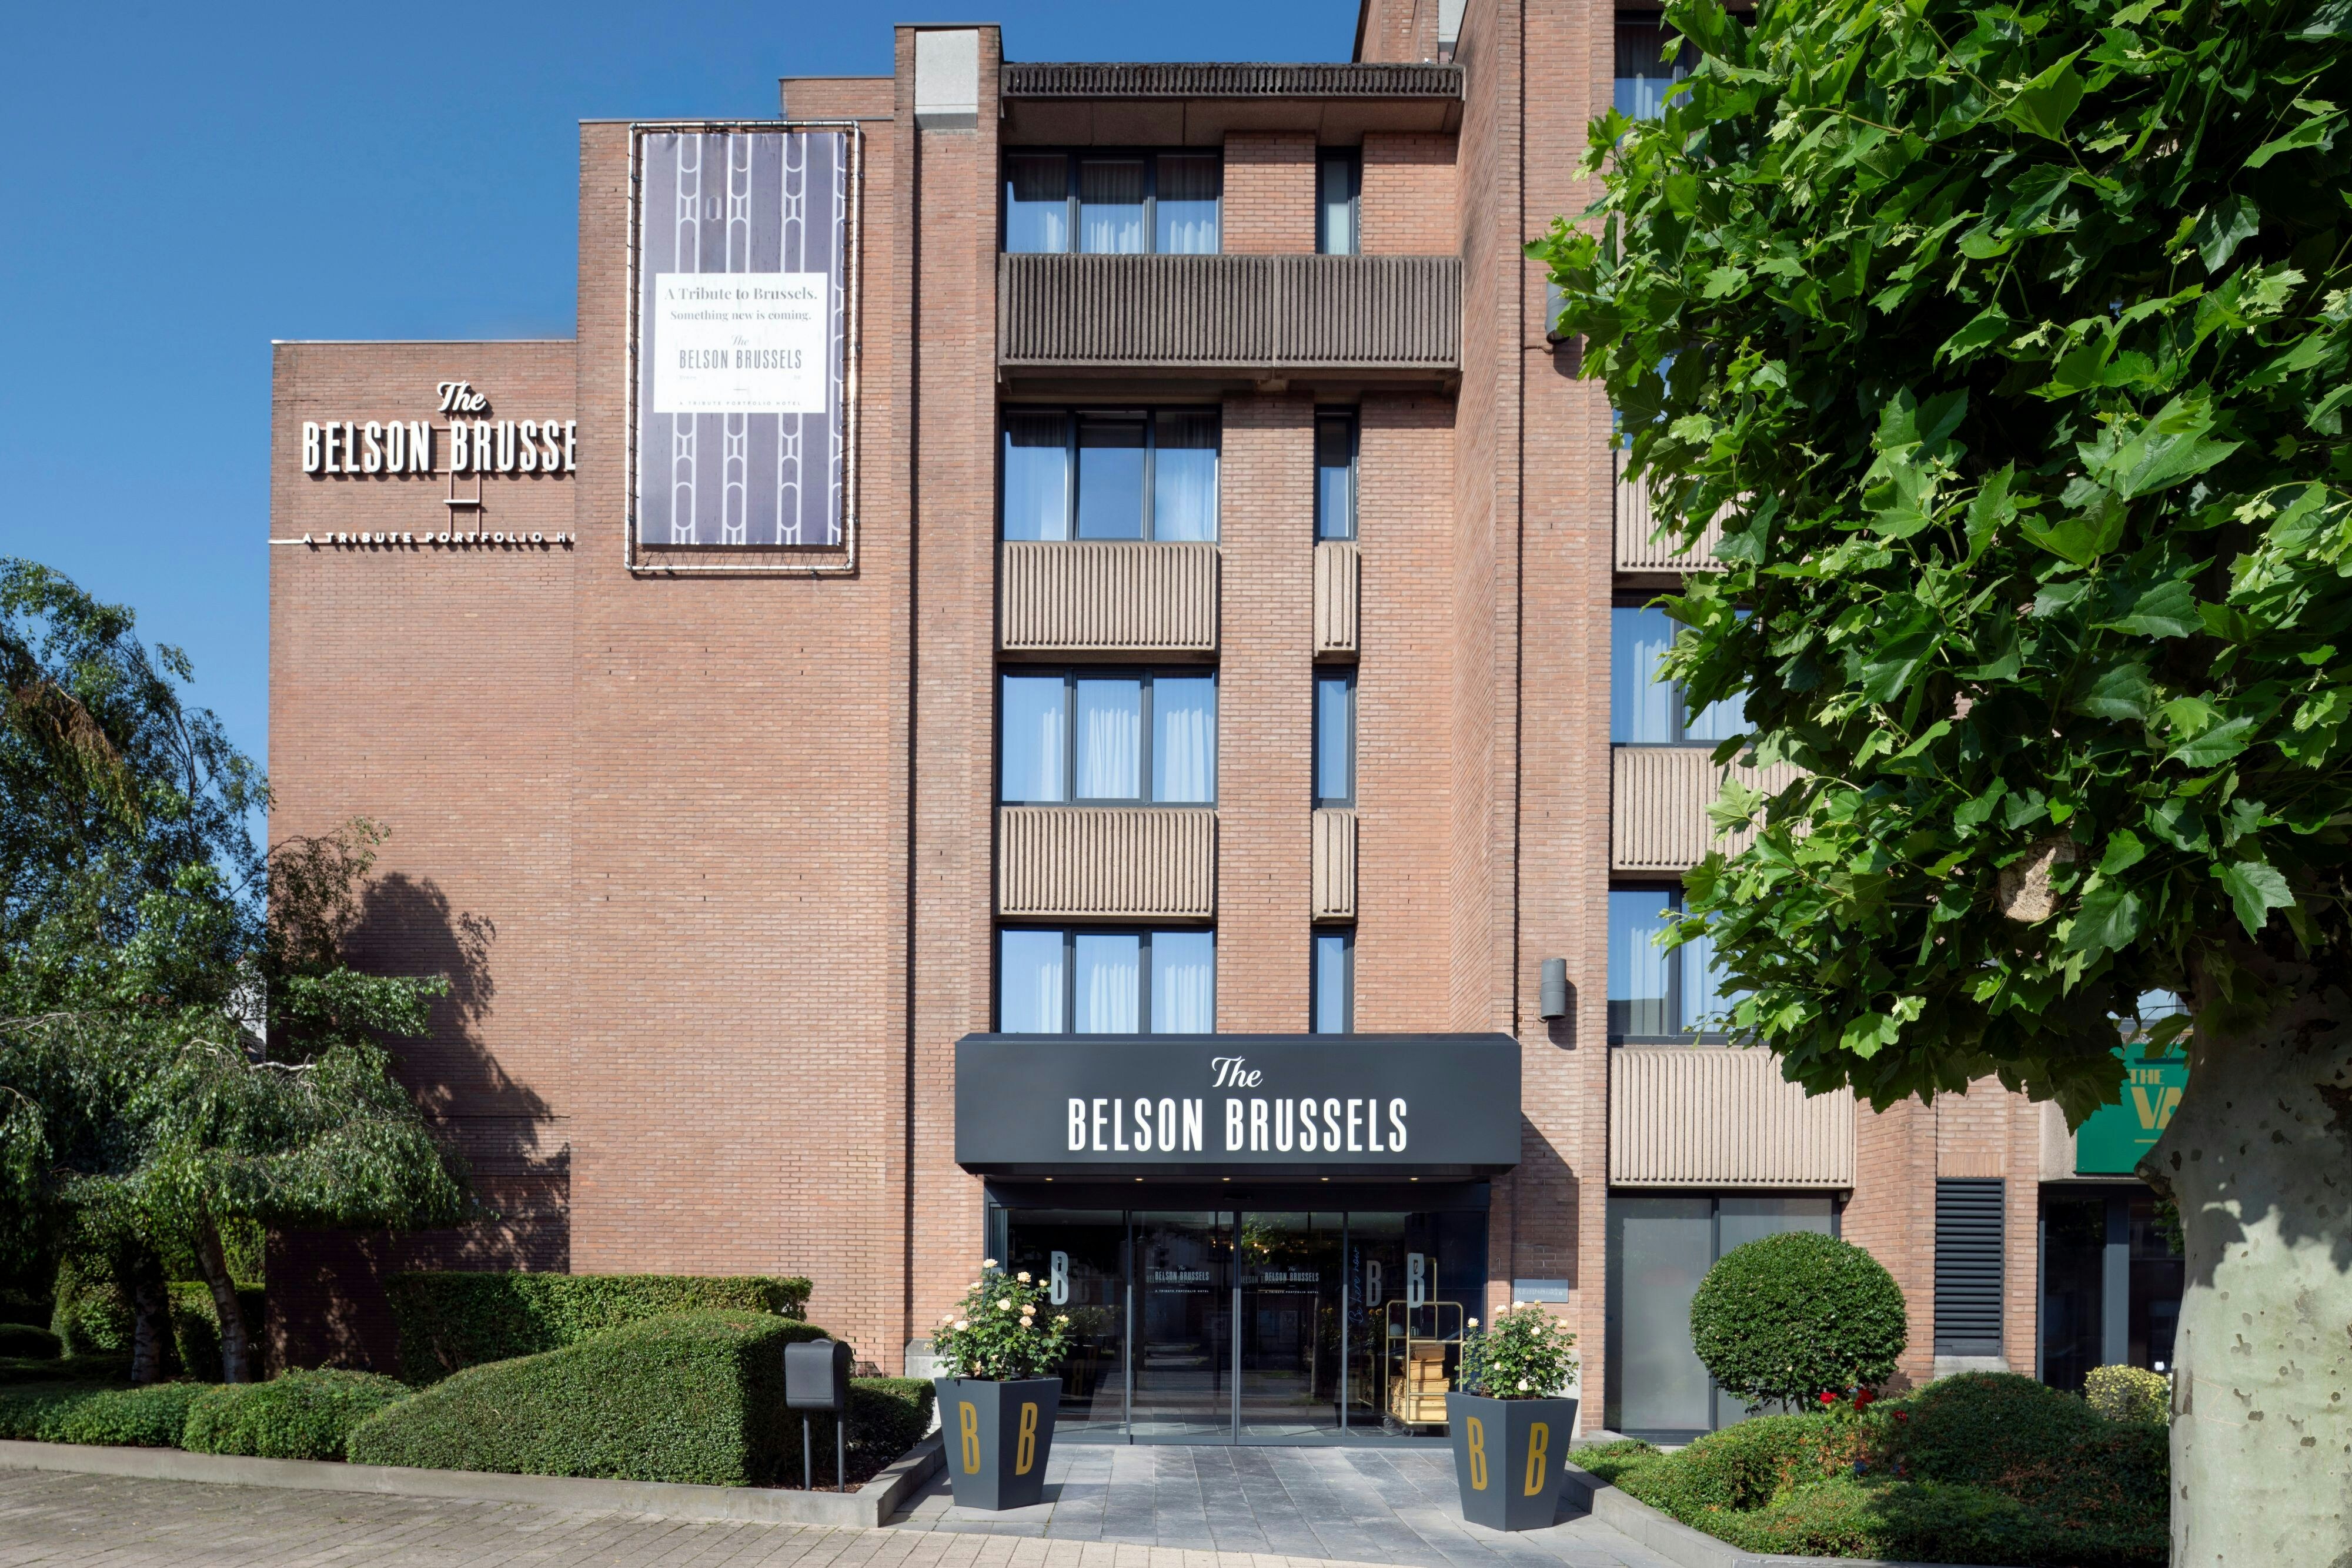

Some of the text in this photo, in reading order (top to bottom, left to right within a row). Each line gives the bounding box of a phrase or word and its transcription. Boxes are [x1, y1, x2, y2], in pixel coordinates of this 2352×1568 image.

[664, 287, 818, 300] A Tribute to Brussels.
[670, 310, 812, 322] Something new is coming.
[730, 334, 750, 346] The
[679, 349, 802, 369] BELSON BRUSSELS
[436, 380, 487, 412] The
[302, 420, 430, 472] BELSON
[302, 533, 312, 543] A
[325, 531, 412, 543] TRIBUTE
[425, 531, 543, 543] PORTFOLIO
[1211, 1055, 1263, 1088] The
[2126, 1069, 2165, 1084] THE
[1068, 1097, 1407, 1152] BELSON BRUSSELS
[1050, 1251, 1069, 1305] B
[1155, 1271, 1177, 1281] BELSON
[1180, 1271, 1210, 1281] BRUSSELS
[1265, 1272, 1287, 1282] BELSON
[1289, 1272, 1319, 1282] BRUSSELS
[1349, 1276, 1362, 1303] here
[1366, 1260, 1382, 1307] B
[1406, 1252, 1425, 1308] B
[1348, 1306, 1364, 1323] Be
[960, 1401, 980, 1475] B
[1015, 1402, 1038, 1476] B
[1466, 1416, 1488, 1491] B
[1524, 1422, 1549, 1496] B
